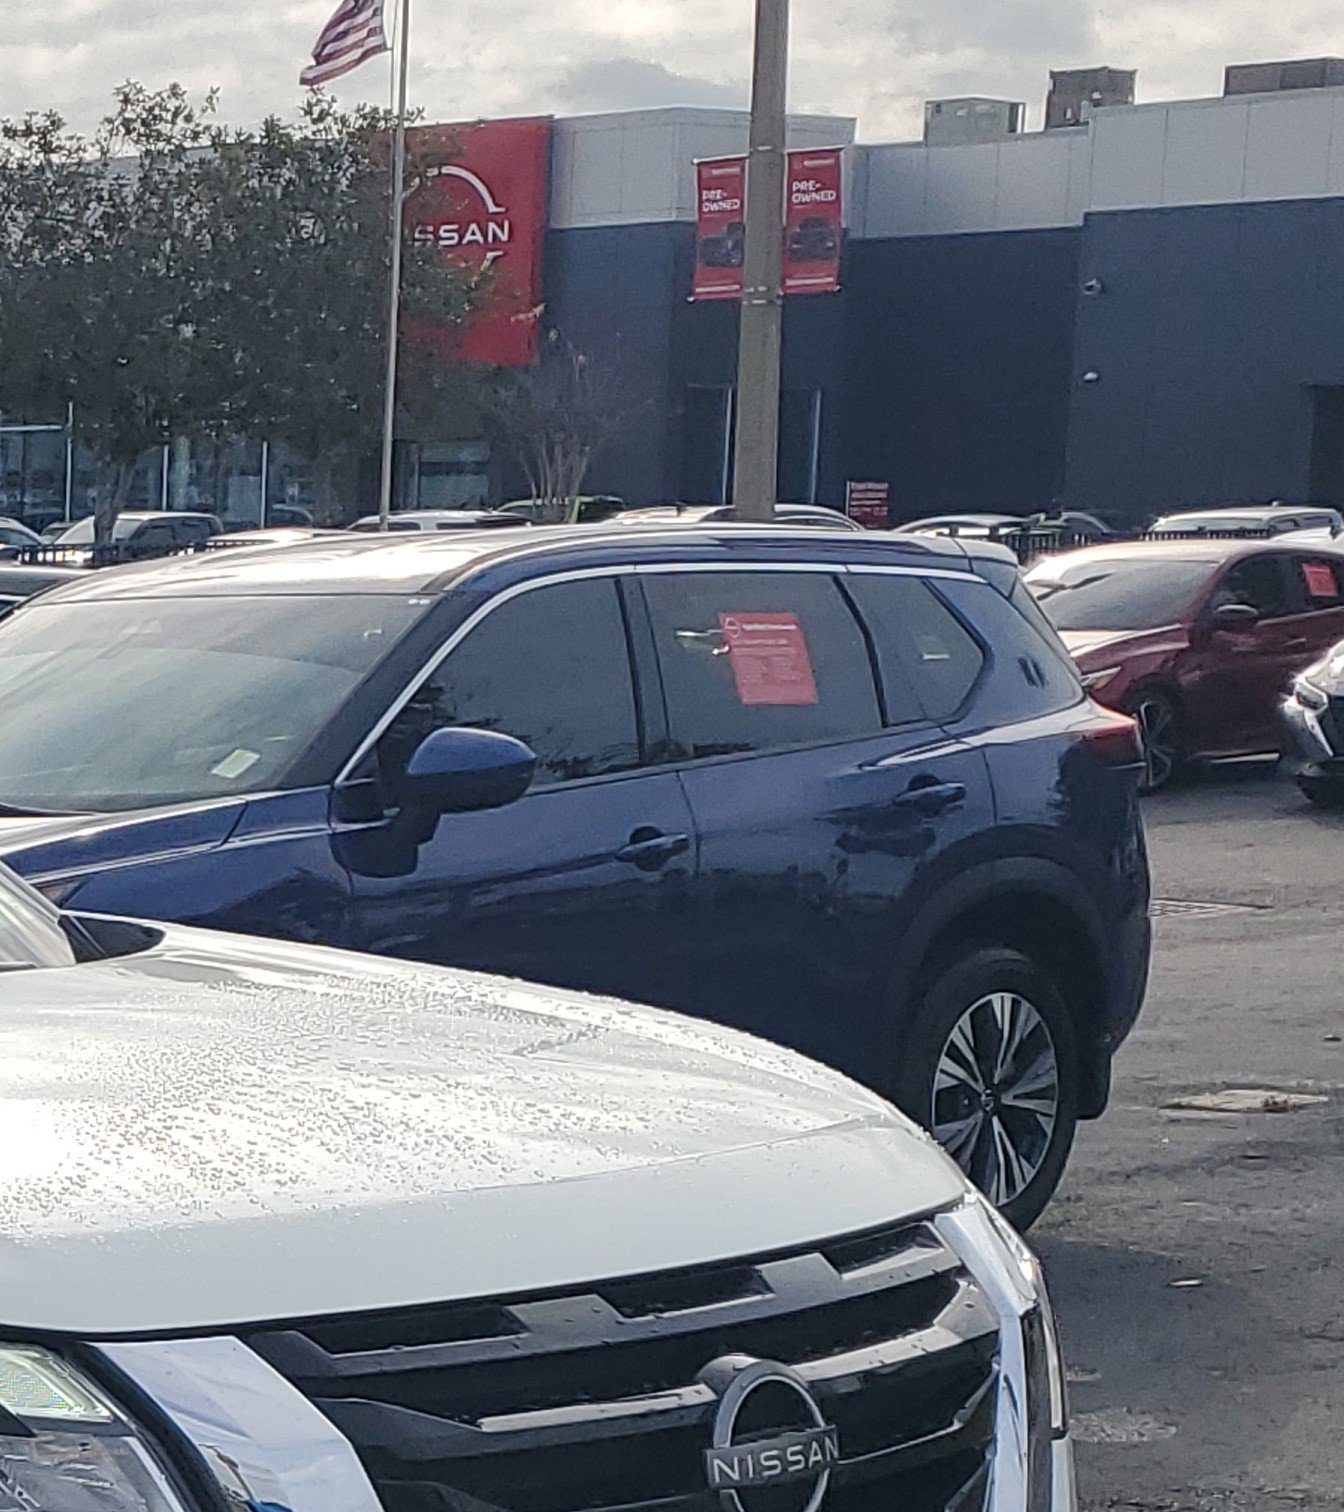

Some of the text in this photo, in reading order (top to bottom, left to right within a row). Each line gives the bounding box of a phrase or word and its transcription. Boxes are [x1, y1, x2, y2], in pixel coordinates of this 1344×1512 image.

[792, 180, 821, 192] PRE-
[702, 189, 727, 201] PRE-
[791, 189, 836, 203] OWNED
[702, 199, 740, 212] OWNED
[413, 219, 510, 247] SSAN
[712, 1435, 839, 1482] NISSAN
